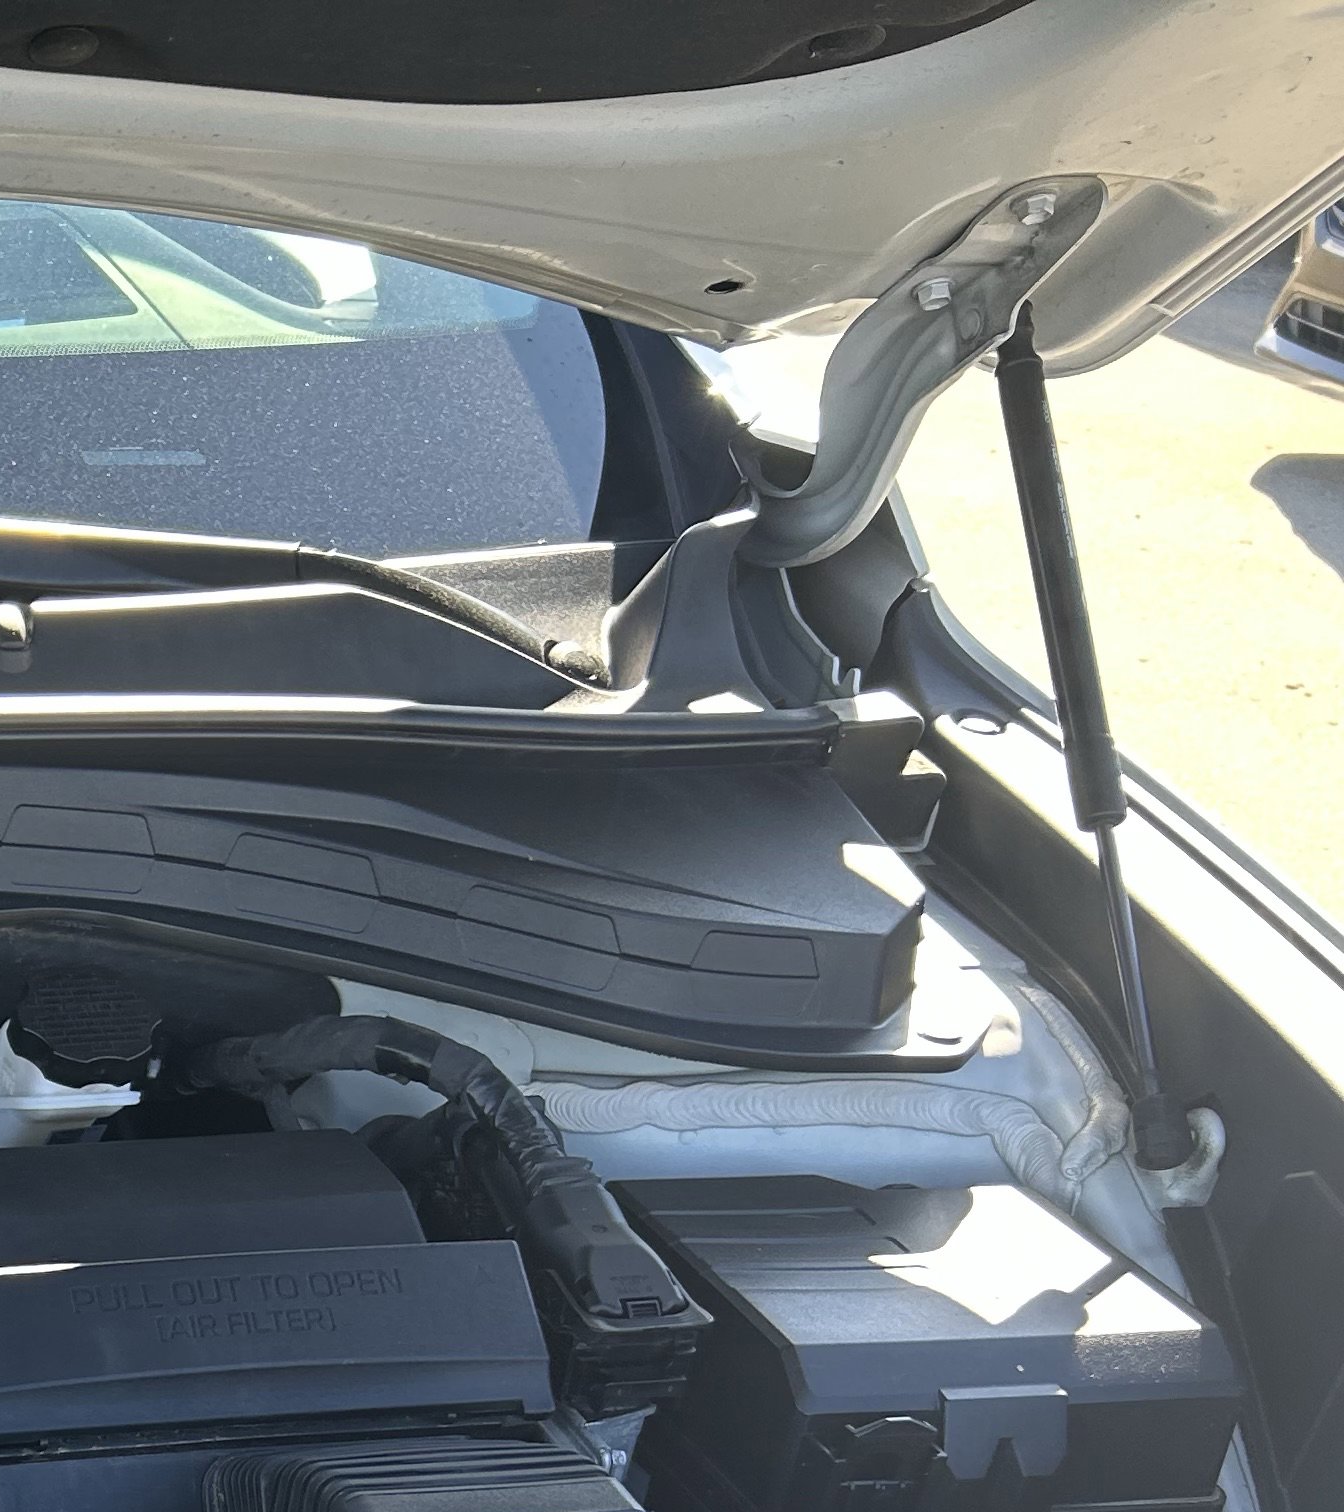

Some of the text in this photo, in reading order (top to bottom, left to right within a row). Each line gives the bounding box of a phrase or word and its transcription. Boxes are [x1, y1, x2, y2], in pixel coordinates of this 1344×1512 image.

[69, 1267, 404, 1314] PULL OUT TO OPEN
